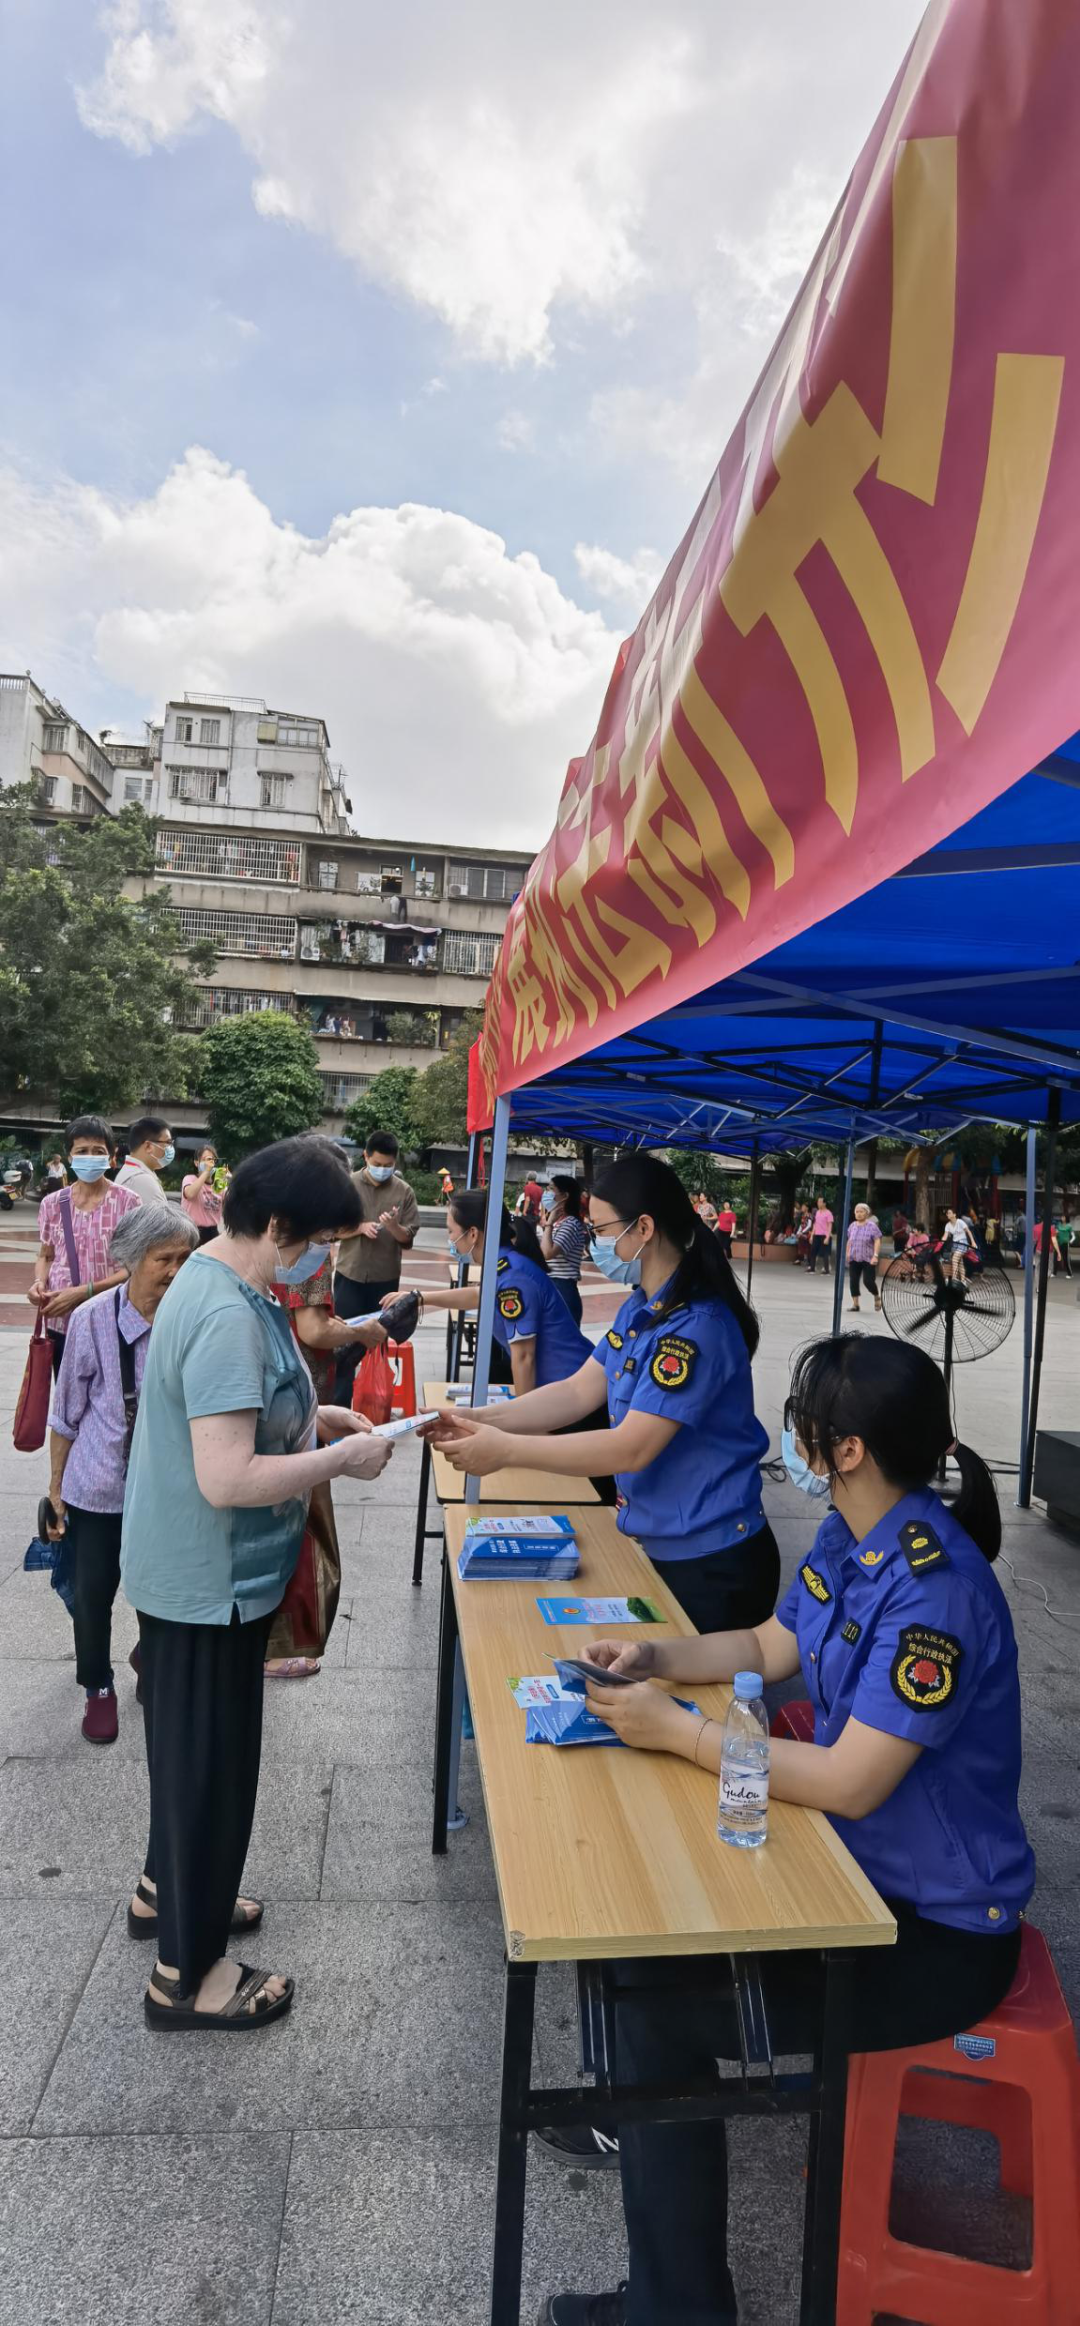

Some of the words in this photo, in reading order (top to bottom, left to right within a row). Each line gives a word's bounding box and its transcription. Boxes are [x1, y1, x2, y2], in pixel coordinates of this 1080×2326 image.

[905, 1632, 960, 1657] 中华人民共和国
[908, 1642, 953, 1664] 综合行政执法
[722, 1781, 761, 1799] Gudou
